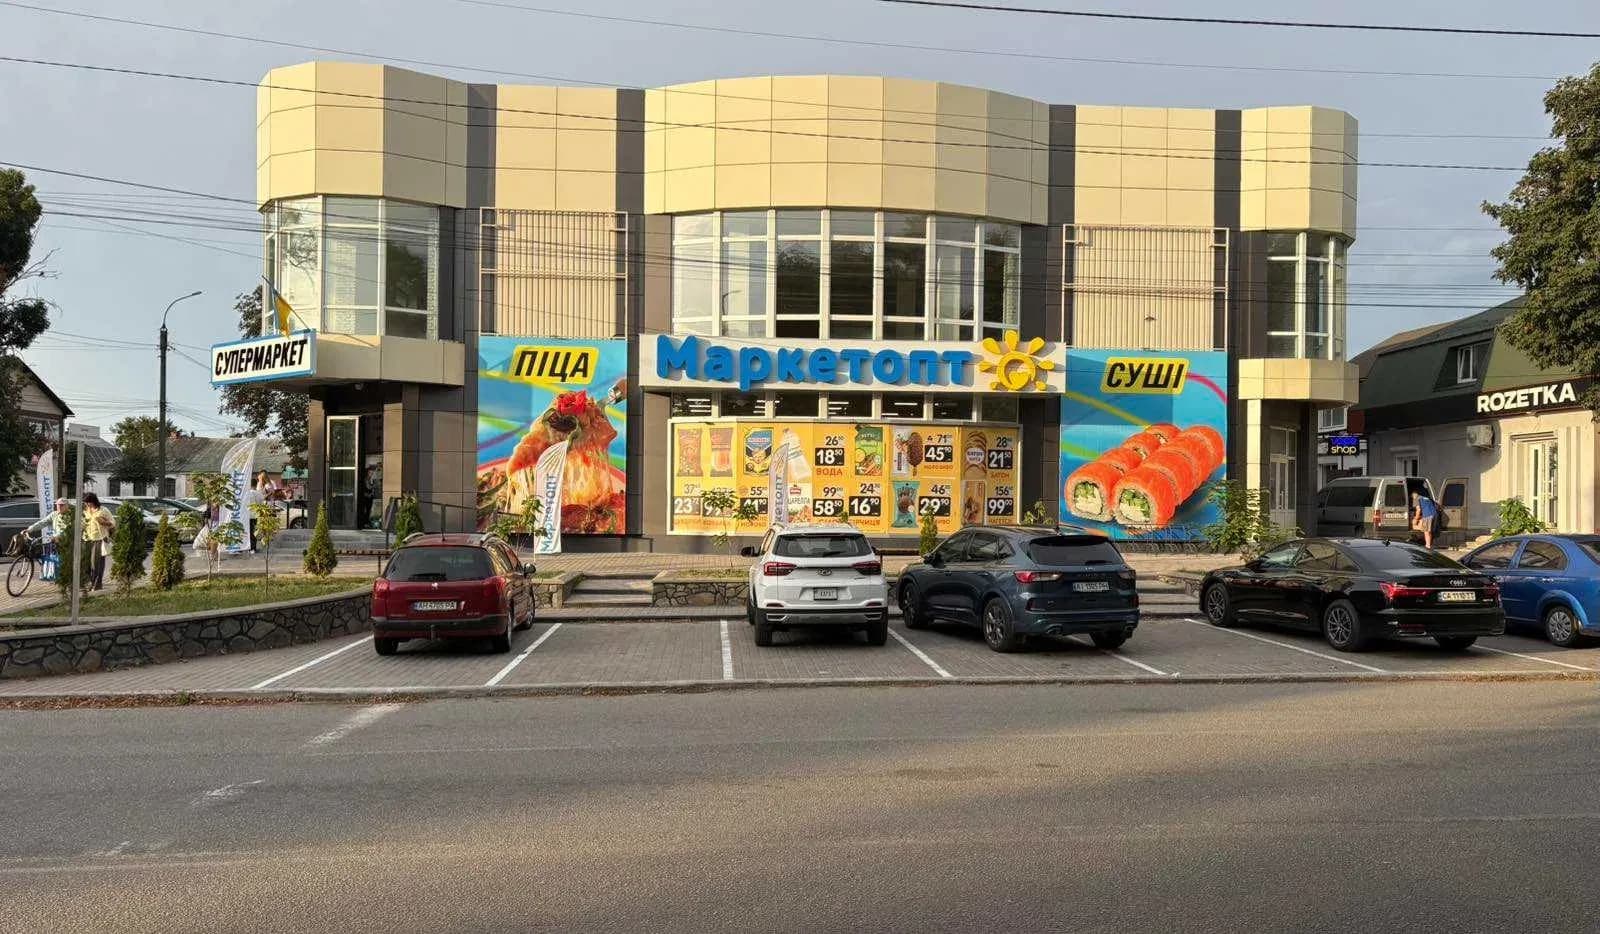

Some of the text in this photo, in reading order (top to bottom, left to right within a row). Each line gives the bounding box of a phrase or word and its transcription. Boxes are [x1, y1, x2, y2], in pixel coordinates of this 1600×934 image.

[215, 339, 308, 376] СУПЕРМАРКЕТ
[514, 350, 589, 382] ПІЦА
[656, 335, 974, 391] Маркетопт
[1106, 362, 1185, 388] СУШІ
[1477, 382, 1576, 413] ROZETKA
[1331, 444, 1357, 455] shop
